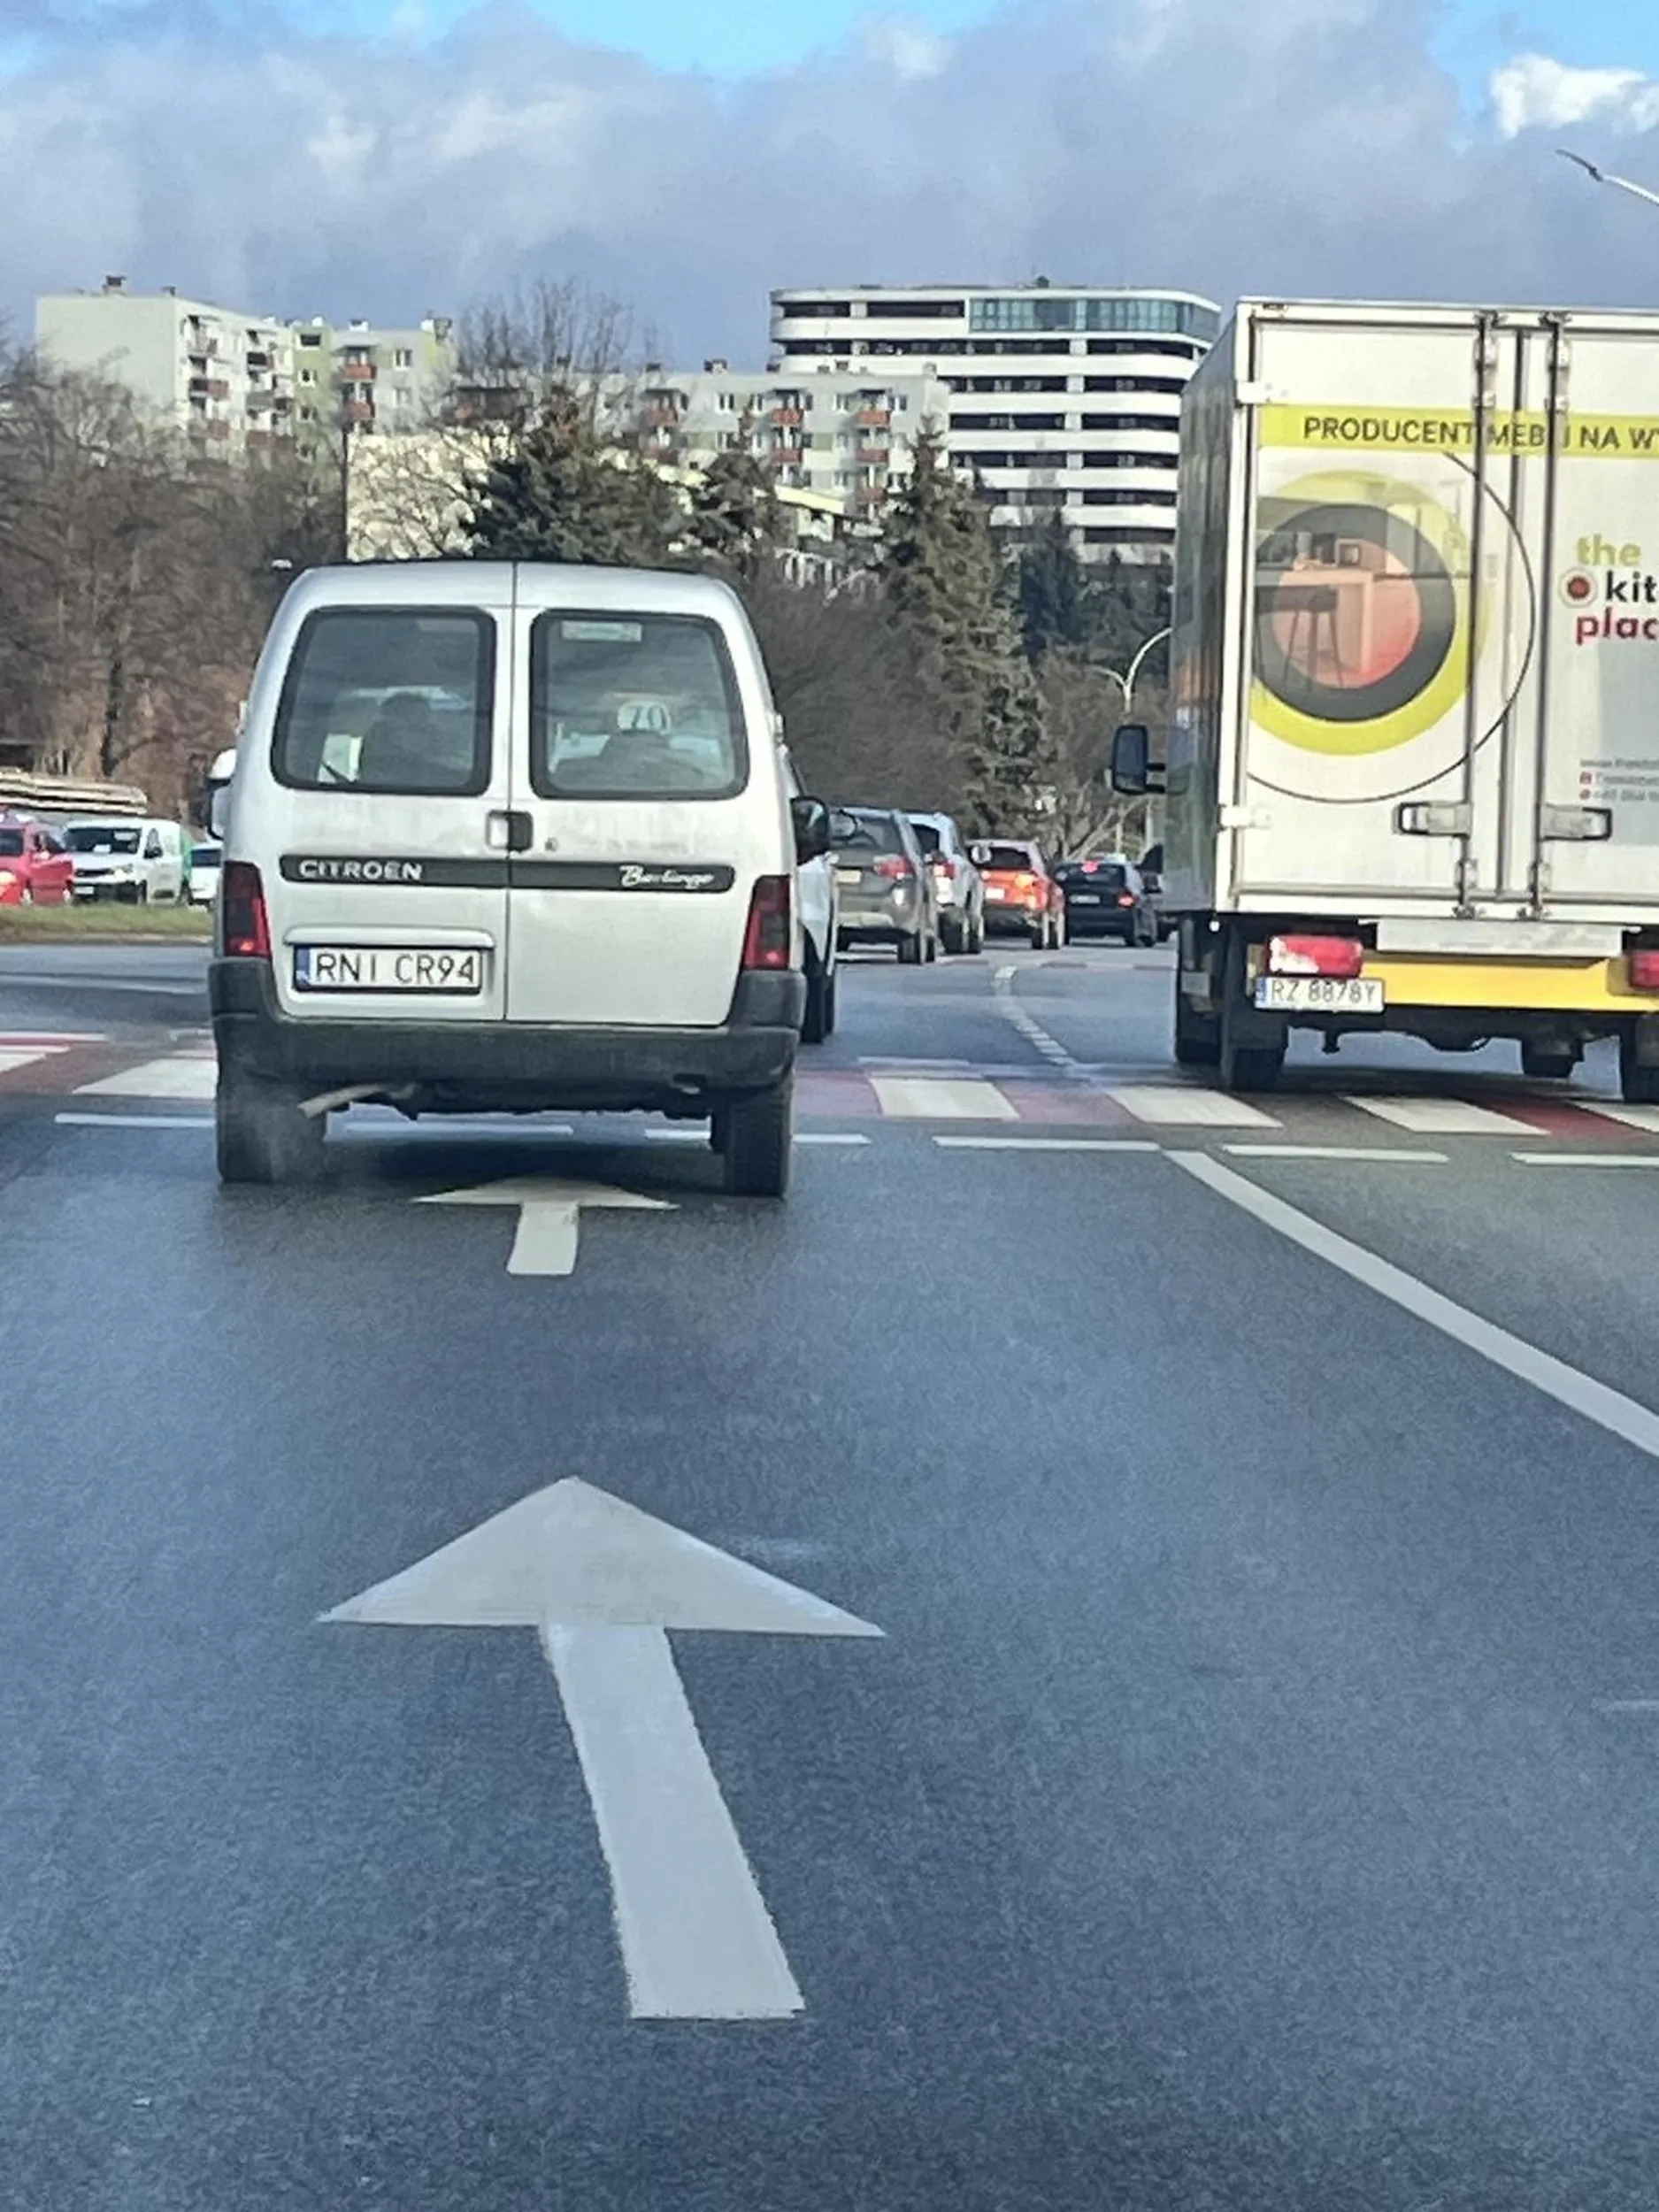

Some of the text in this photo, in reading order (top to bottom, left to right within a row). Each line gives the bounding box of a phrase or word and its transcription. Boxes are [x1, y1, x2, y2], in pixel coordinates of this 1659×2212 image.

[1303, 417, 1473, 443] PRODUCENT
[1486, 422, 1571, 448] MEBI
[1579, 426, 1621, 449] NA
[1578, 534, 1641, 566] the
[1606, 569, 1657, 603] kit
[1576, 605, 1659, 646] plac
[316, 952, 474, 984] RNI CR94
[1271, 979, 1375, 1003] RZ 8878Y
